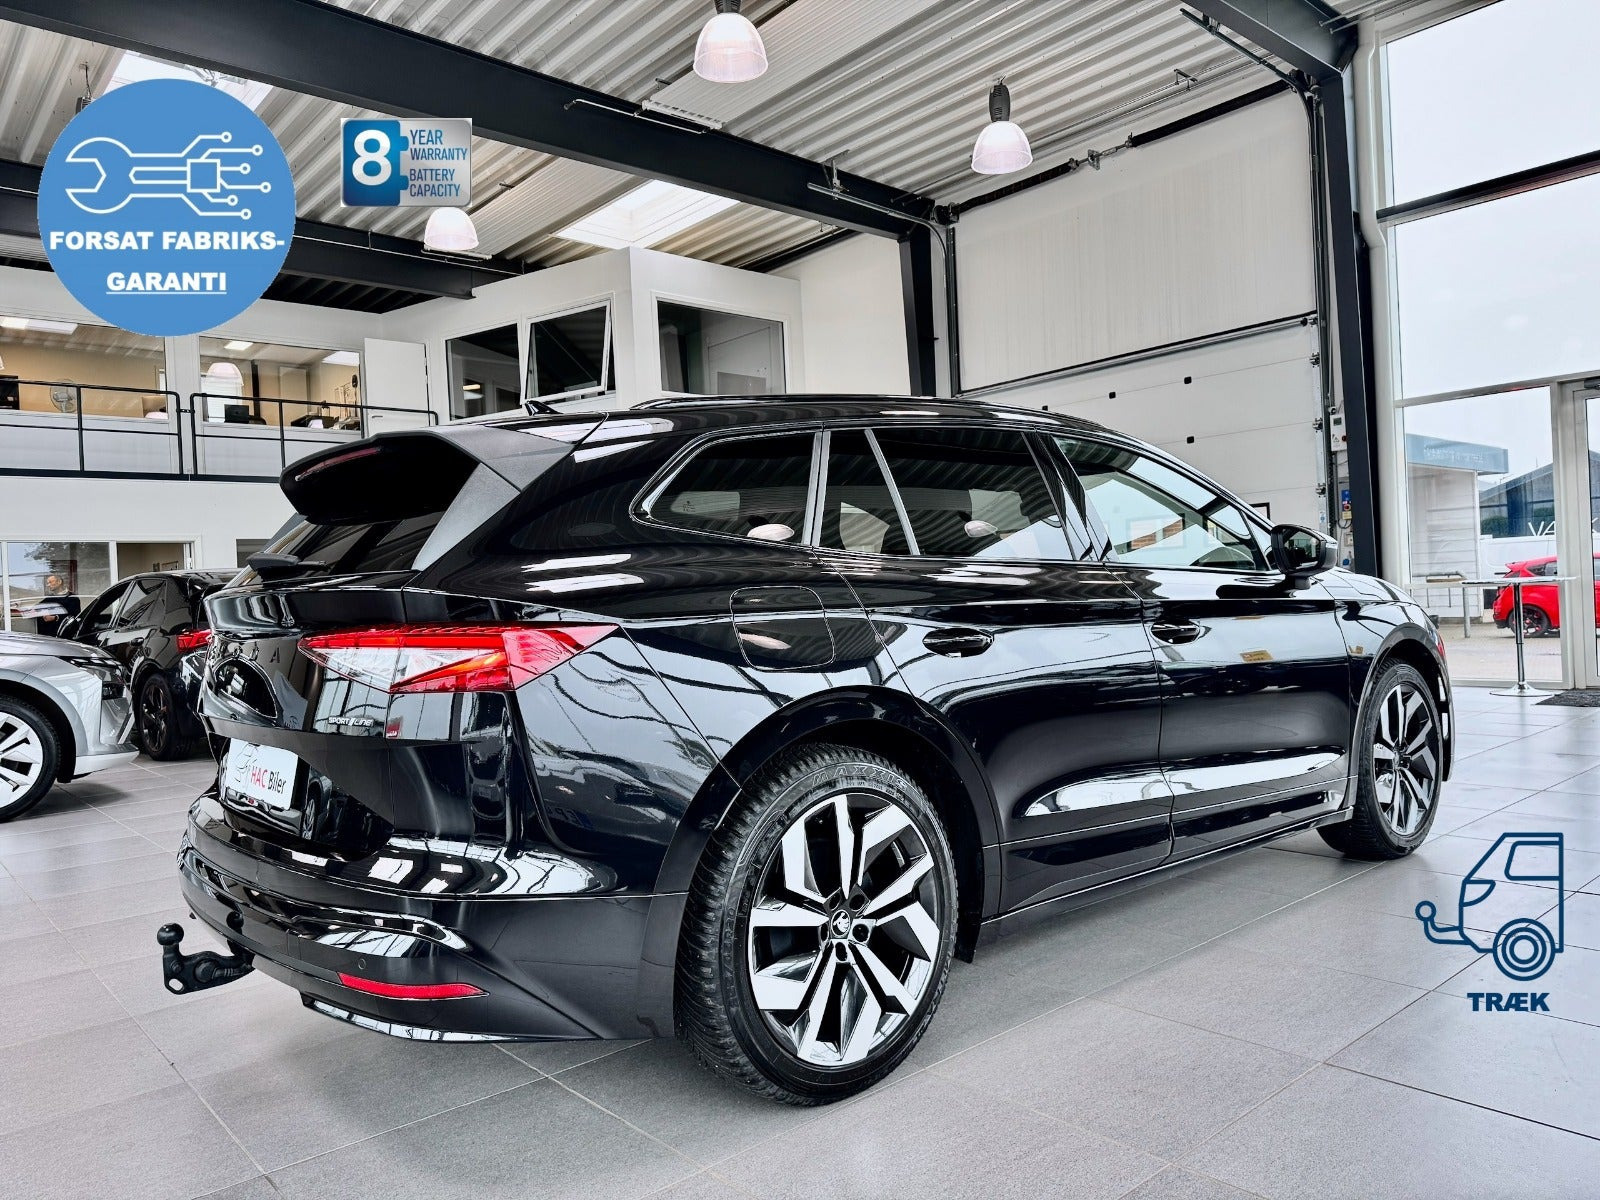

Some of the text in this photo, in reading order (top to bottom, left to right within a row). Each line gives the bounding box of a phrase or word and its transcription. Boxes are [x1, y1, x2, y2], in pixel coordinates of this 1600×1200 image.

[250, 765, 287, 794] HAC Biler
[811, 765, 907, 792] MAXXIS
